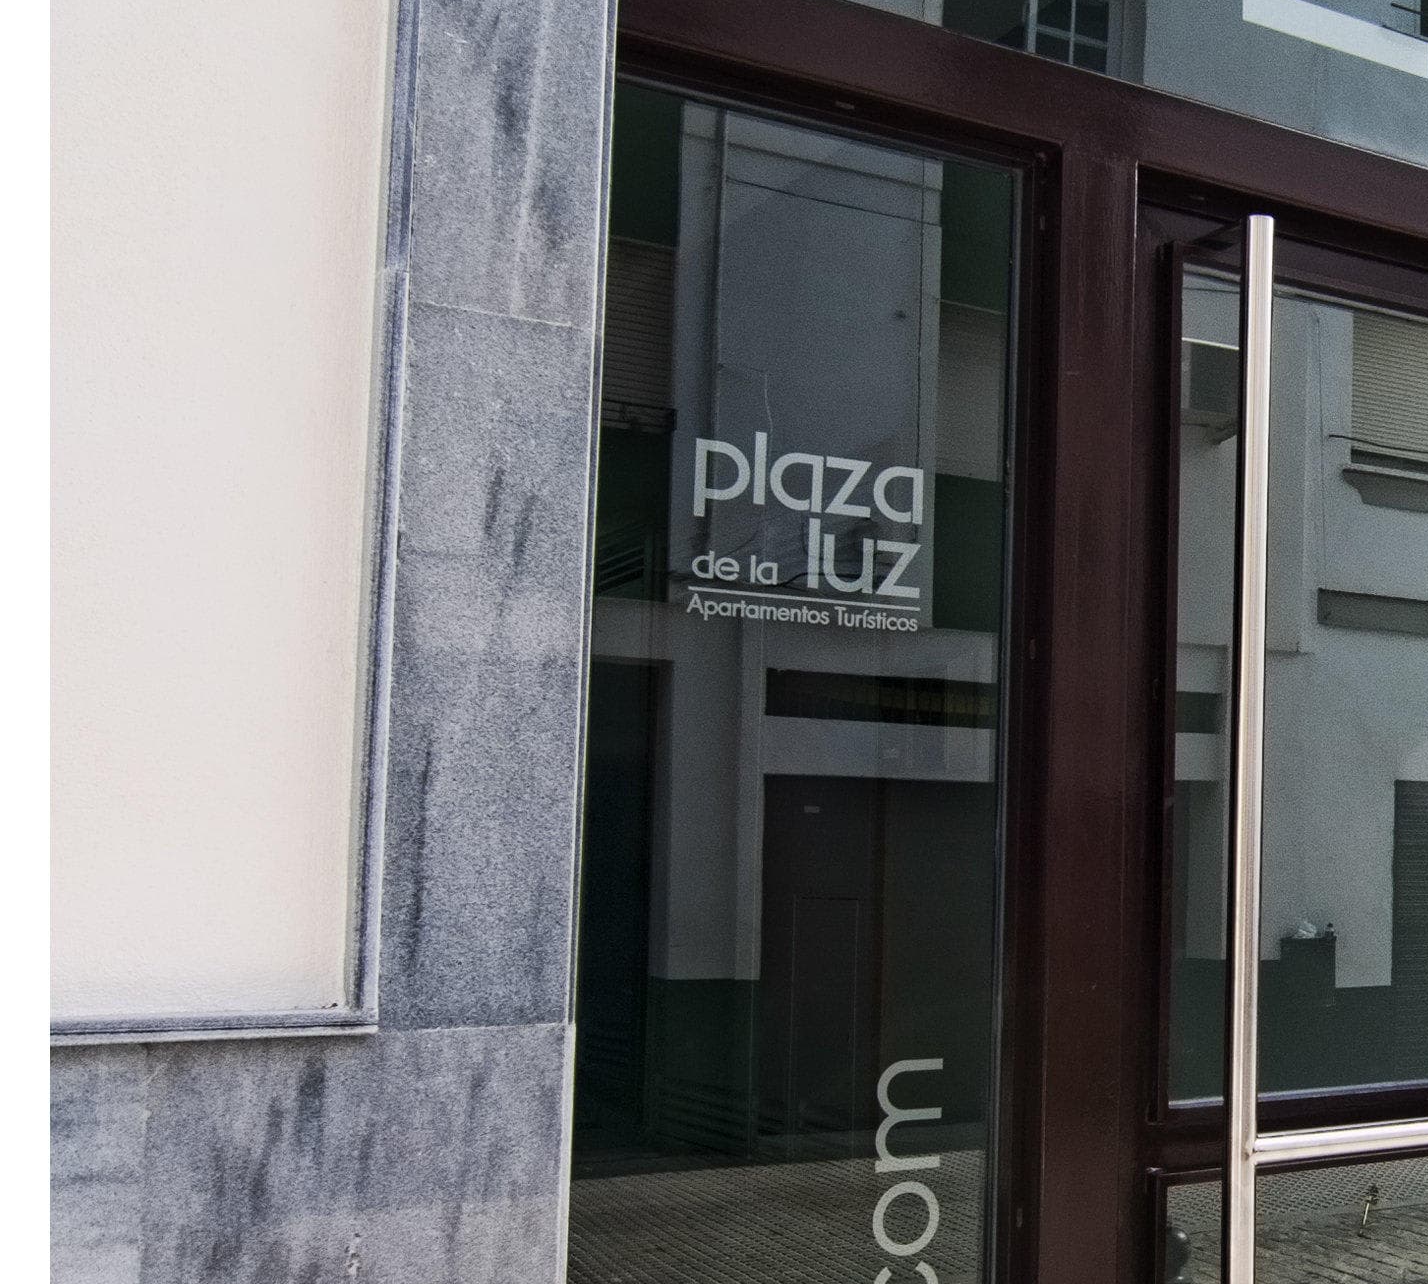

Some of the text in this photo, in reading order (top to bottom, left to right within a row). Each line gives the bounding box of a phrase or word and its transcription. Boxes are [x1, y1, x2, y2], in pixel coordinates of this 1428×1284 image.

[693, 431, 924, 525] plaza
[691, 517, 922, 599] de la luz
[686, 593, 919, 632] Apartamentos Turísticos
